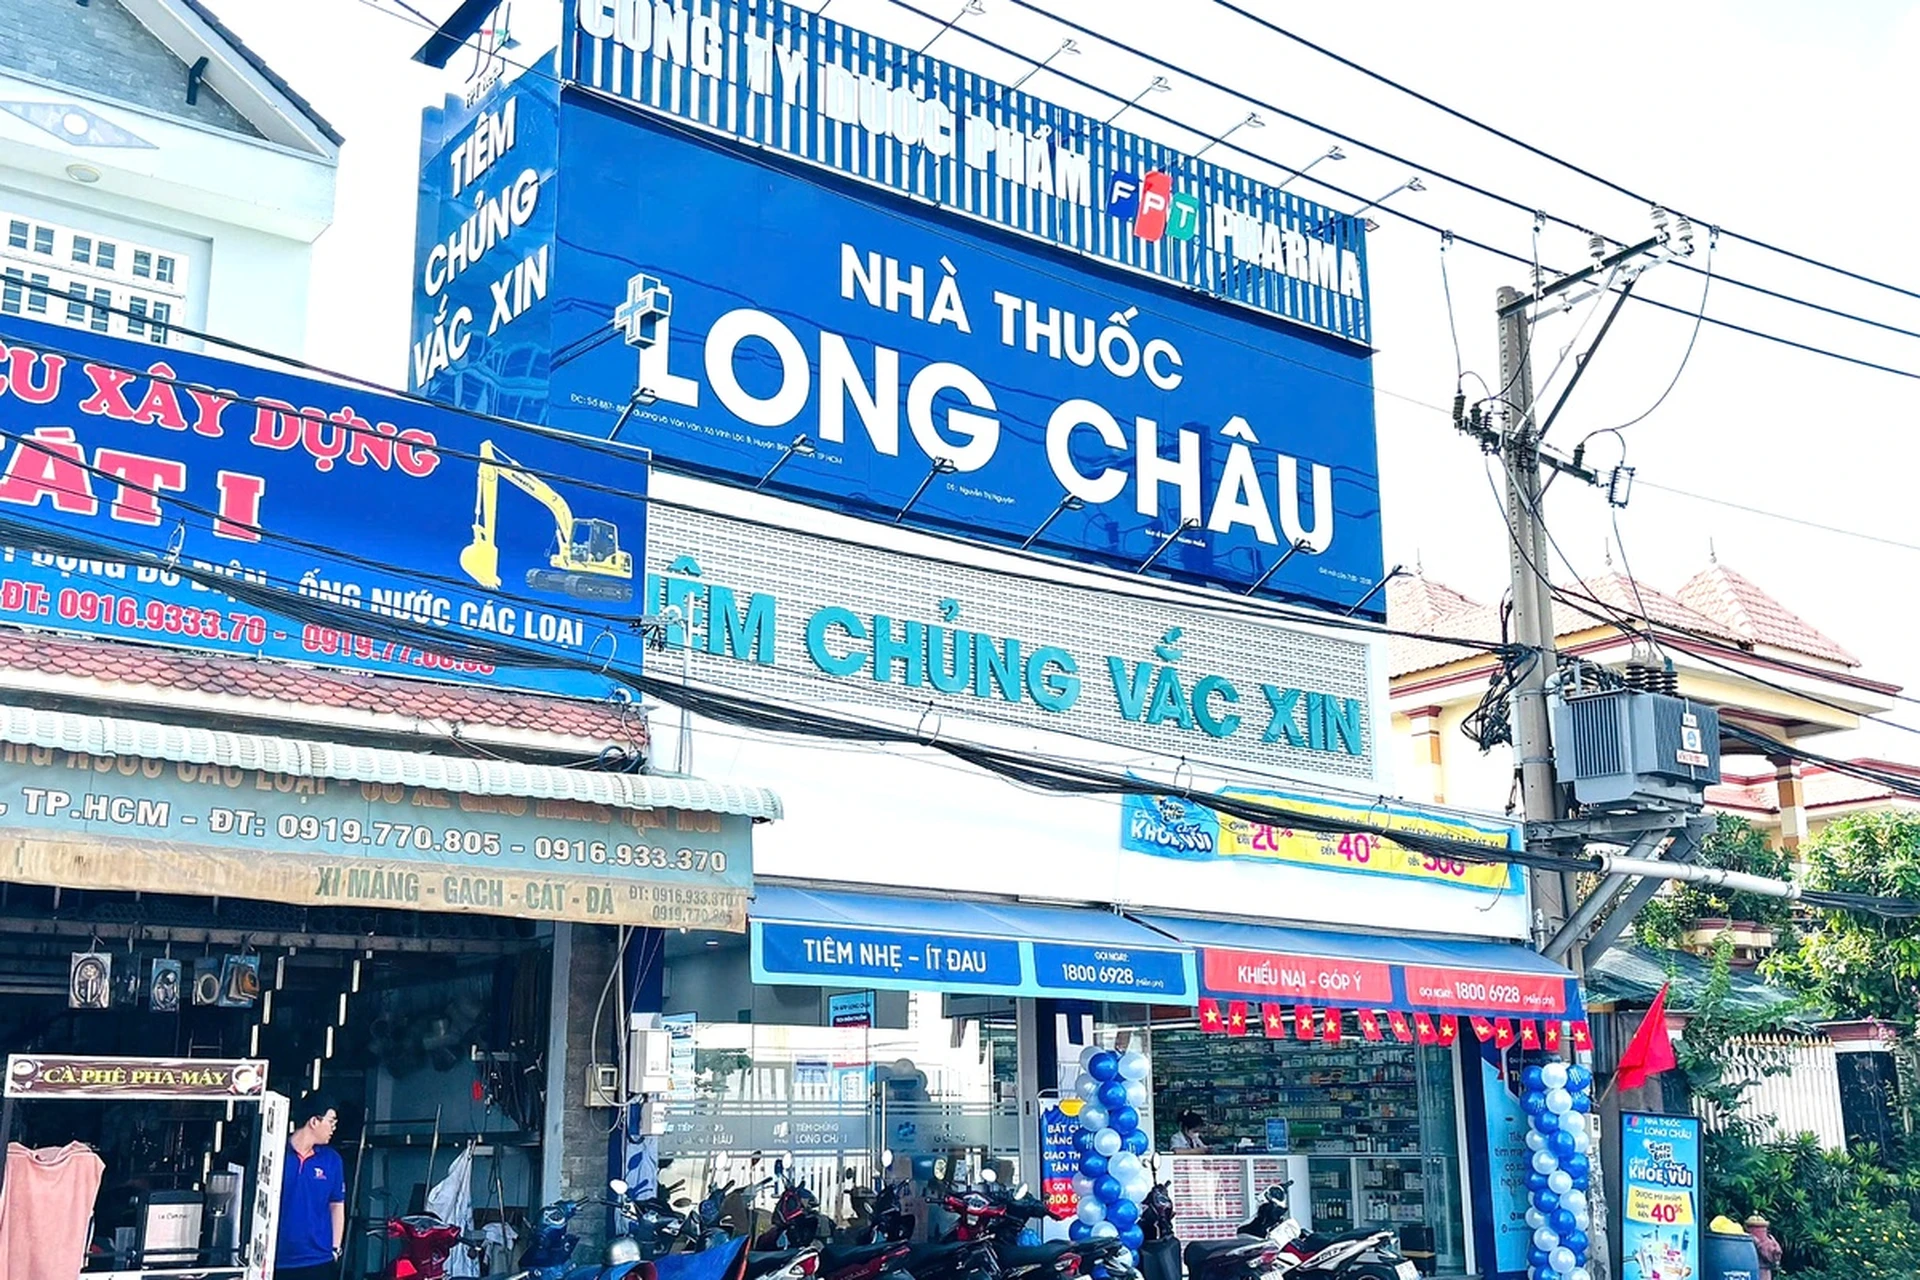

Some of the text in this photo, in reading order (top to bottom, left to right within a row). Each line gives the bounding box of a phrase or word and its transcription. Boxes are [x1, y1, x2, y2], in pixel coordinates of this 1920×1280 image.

[451, 96, 517, 198] TIÊM
[743, 31, 807, 107] TY
[1111, 178, 1196, 232] FPT
[1213, 201, 1361, 299] PHARMA
[424, 168, 539, 297] CHỦNG
[414, 244, 549, 389] VẮC XIN
[841, 242, 1185, 391] NHÀ THUỐC
[0, 343, 441, 477] U XÂY DỰNG
[638, 284, 1335, 556] LONG CHÂU
[0, 426, 266, 543] ÁT I
[1, 579, 50, 615] ĐT:
[57, 588, 267, 645] 0916.9333.70
[459, 599, 517, 636] CÁC
[524, 610, 584, 651] LOẠI
[647, 555, 1363, 756] IÊM CHỦNG VẮC XIN
[21, 787, 170, 828] TP.HCM
[208, 807, 267, 837] ĐT:
[276, 814, 502, 858] 0919.770.805
[533, 836, 728, 875] 0916.933.370
[315, 865, 342, 898] XI
[346, 863, 420, 902] MĂNG
[525, 877, 567, 912] CÁT
[586, 881, 615, 915] ĐÁ
[803, 936, 854, 965] TIÊM
[859, 943, 903, 973] NHẸ
[925, 943, 942, 970] ÍT
[946, 949, 987, 973] ĐAU
[1062, 963, 1097, 983] 1800
[1099, 966, 1134, 985] 6928
[1237, 960, 1279, 986] KHIẾU
[1280, 968, 1306, 993] NẠI
[1318, 968, 1350, 991] GÓP
[1352, 970, 1362, 992] Ý
[1455, 982, 1486, 1001] 1800
[1488, 983, 1520, 1003] 6928
[1043, 1151, 1066, 1160] GIAO
[1650, 1203, 1684, 1223] 40%
